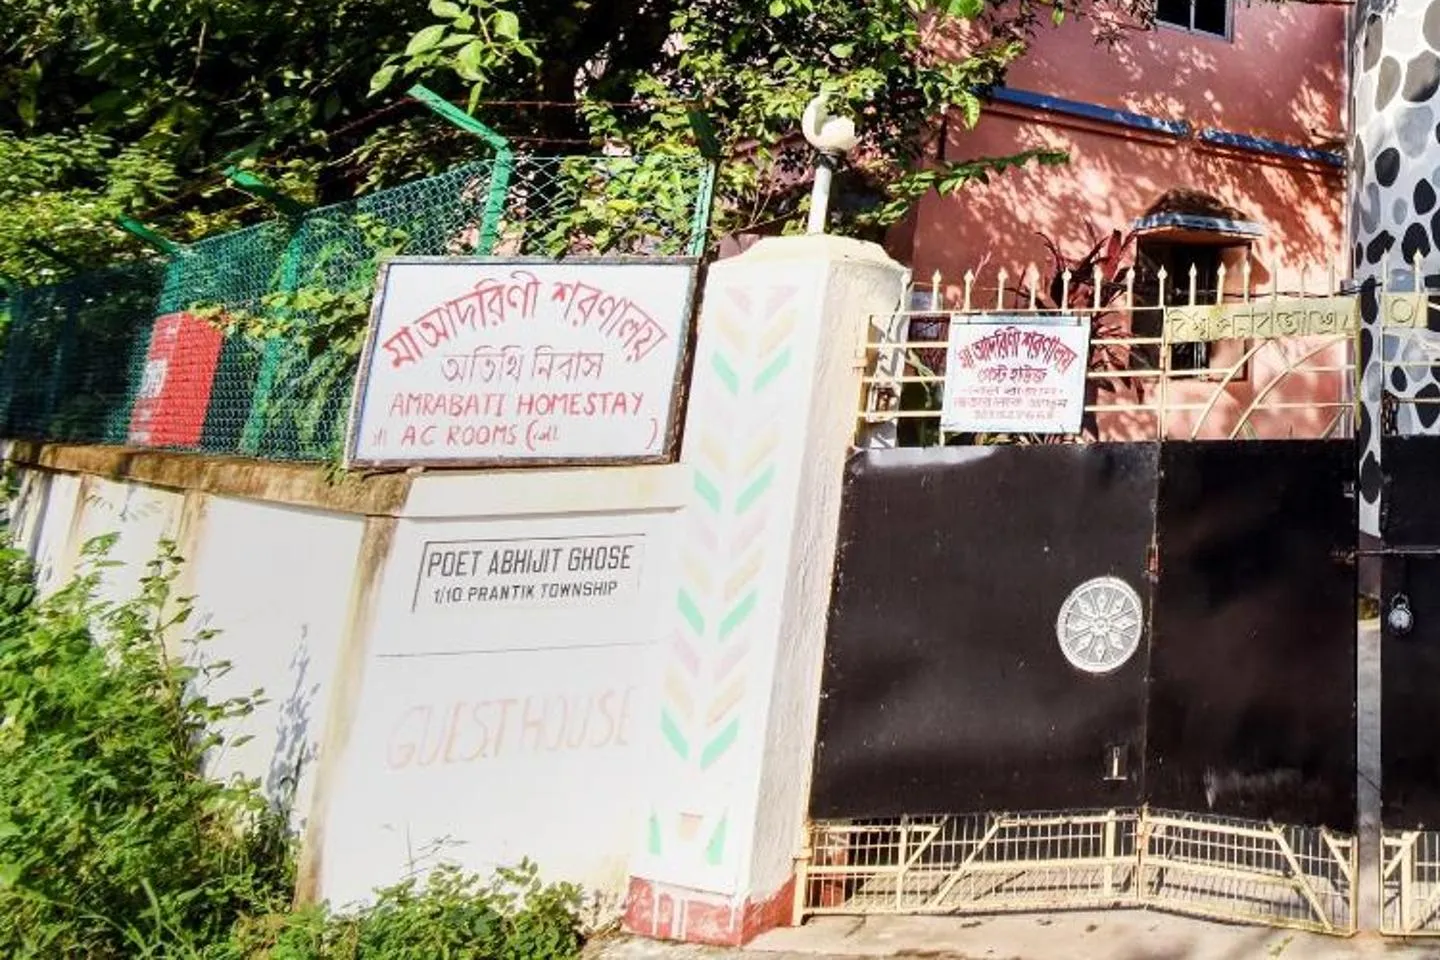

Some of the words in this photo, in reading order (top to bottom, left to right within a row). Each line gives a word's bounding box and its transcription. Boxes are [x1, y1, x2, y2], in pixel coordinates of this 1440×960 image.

[381, 323, 423, 368] মা
[389, 392, 506, 417] AMRABATI
[517, 391, 644, 416] HOMESTAY
[401, 425, 437, 446] AC
[447, 424, 518, 446] ROOMS
[427, 551, 482, 577] POET
[488, 548, 563, 575] ABHIJIT
[568, 545, 634, 572] GHOSE
[434, 586, 462, 604] 1/10
[468, 584, 534, 602] PRANTIK
[541, 581, 618, 599] TOWNSHIP
